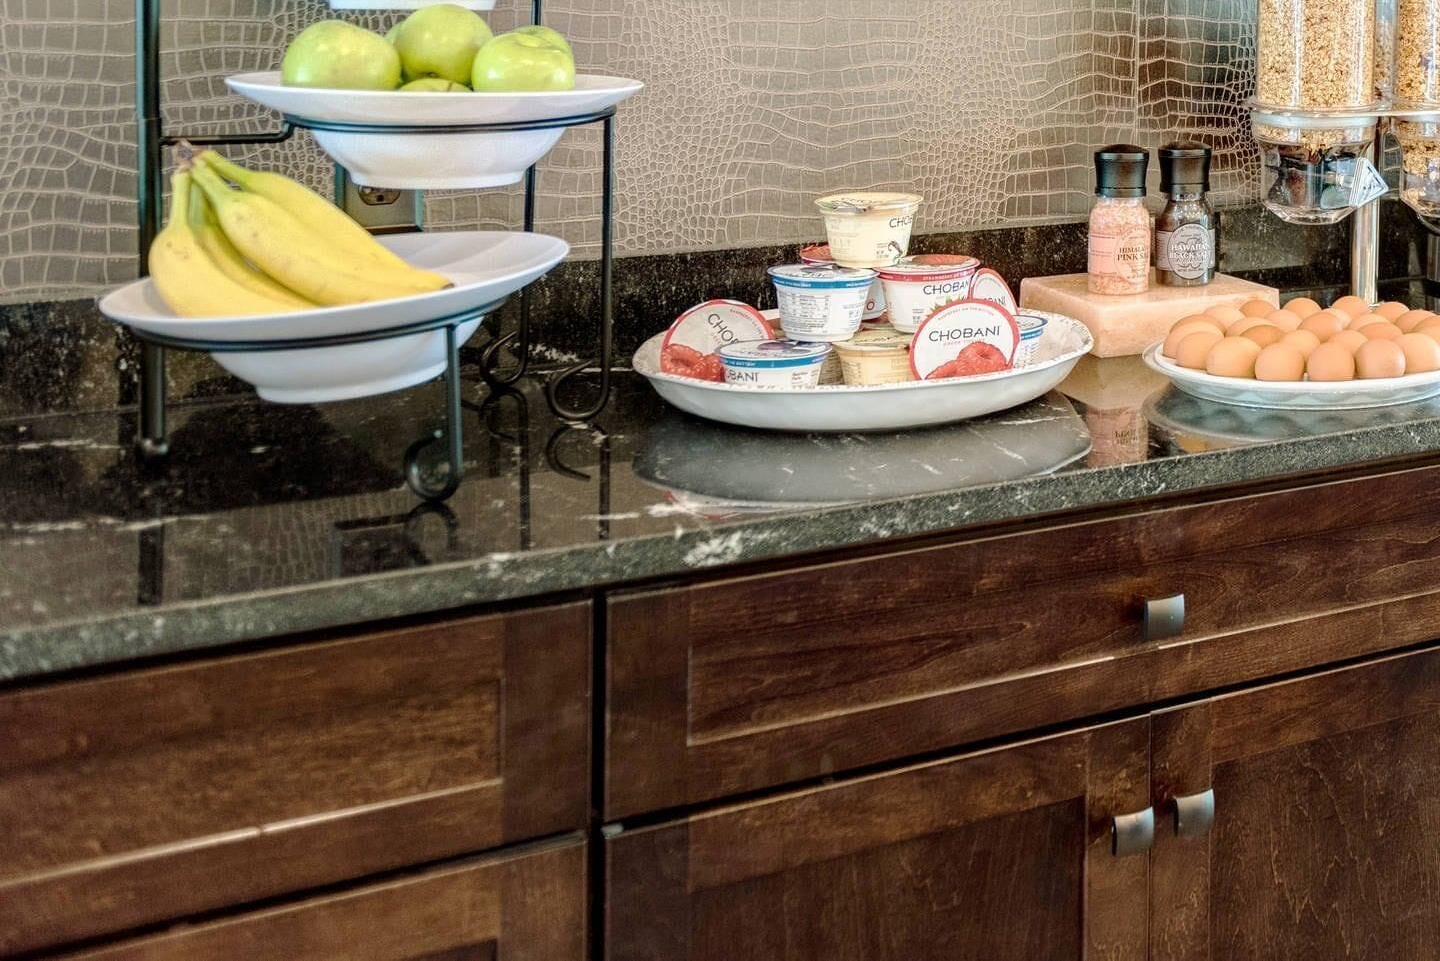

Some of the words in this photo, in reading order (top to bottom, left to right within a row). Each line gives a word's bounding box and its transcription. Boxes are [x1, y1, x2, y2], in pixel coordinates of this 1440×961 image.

[923, 280, 969, 295] CHOBAN
[928, 325, 1000, 342] CHOBANI
[727, 368, 759, 383] BANI
